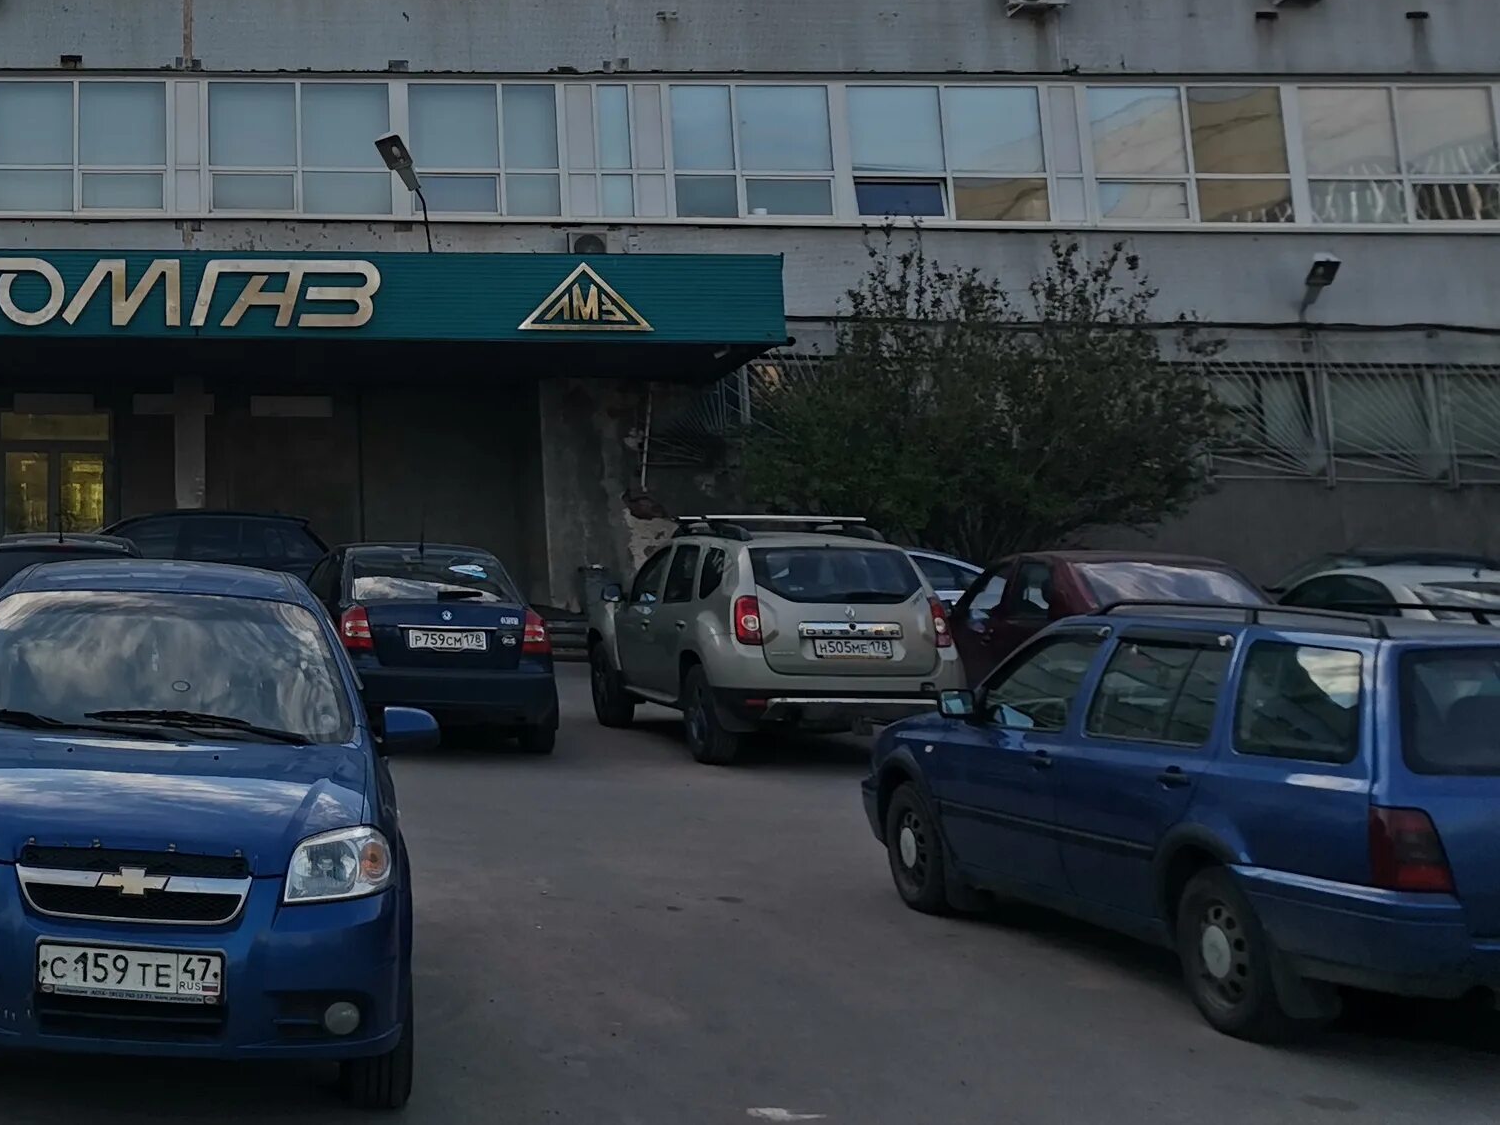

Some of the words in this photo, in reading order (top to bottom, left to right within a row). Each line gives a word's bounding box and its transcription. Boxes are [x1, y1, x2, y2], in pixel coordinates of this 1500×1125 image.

[464, 634, 481, 644] 178
[182, 957, 212, 981] 47
[179, 981, 202, 991] RUS
